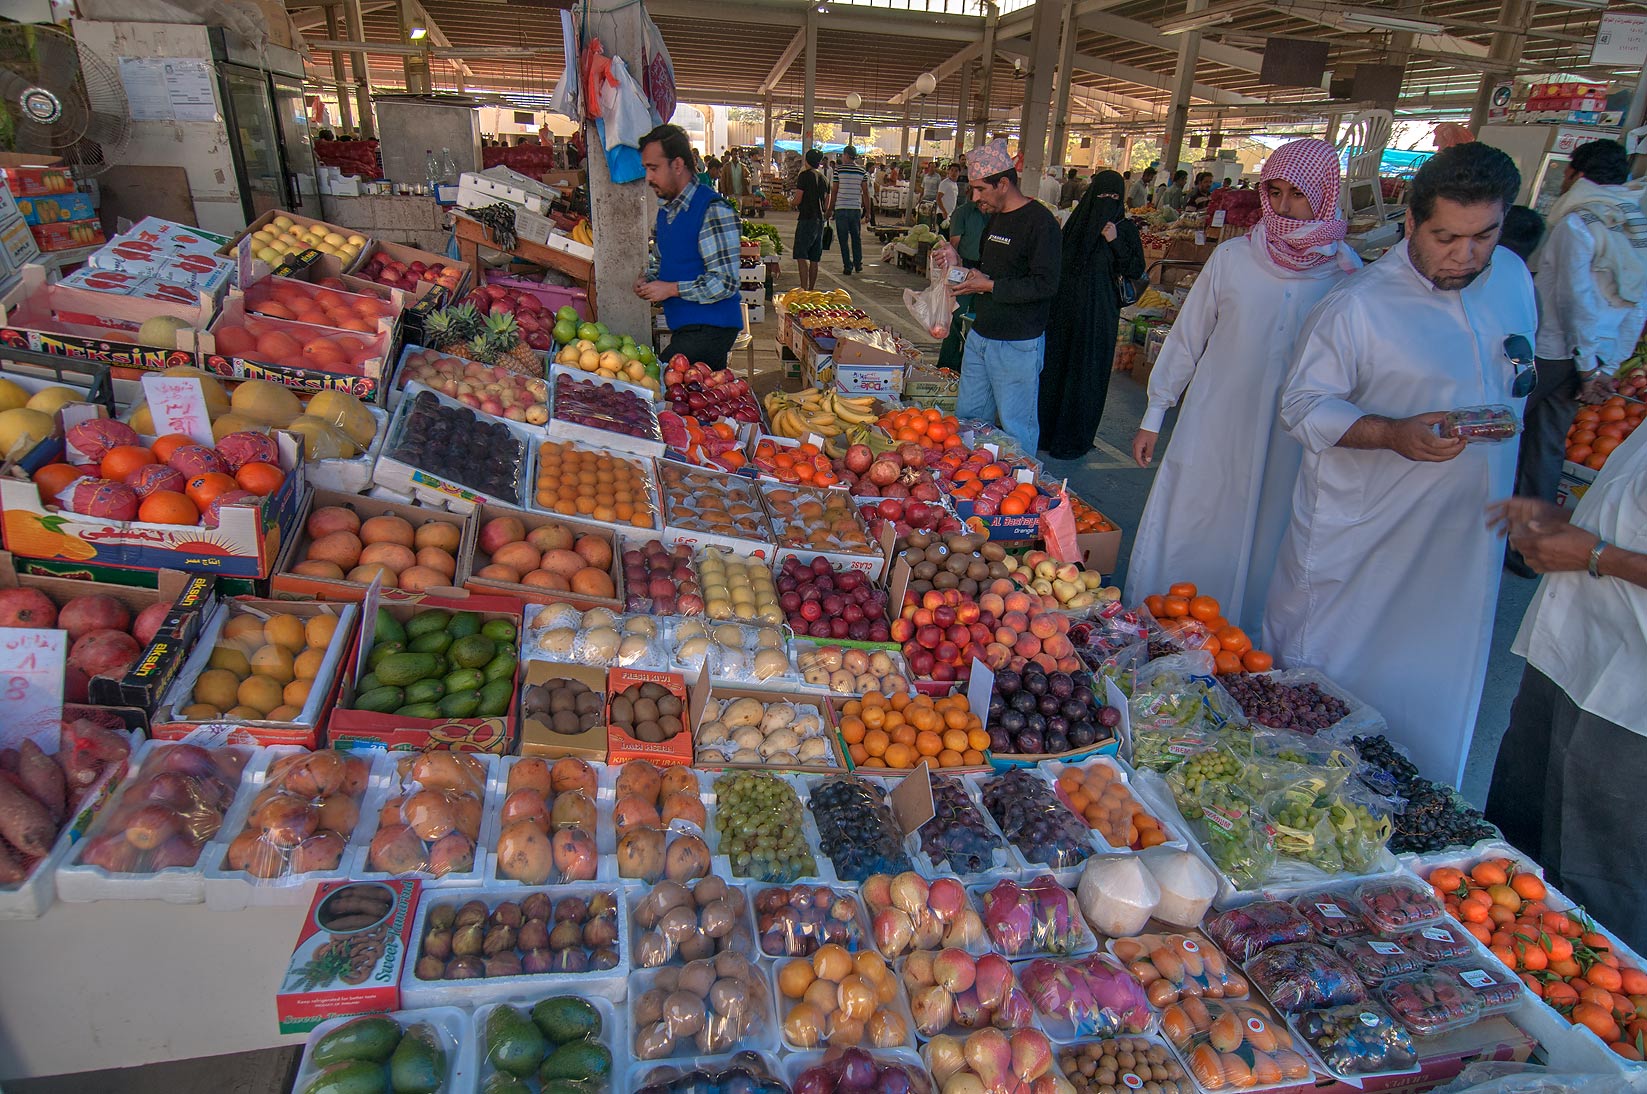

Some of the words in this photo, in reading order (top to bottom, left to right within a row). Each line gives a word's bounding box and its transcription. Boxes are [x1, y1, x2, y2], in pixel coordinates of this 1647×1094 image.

[861, 382, 881, 391] Dole
[622, 672, 650, 681] FRESH
[651, 674, 671, 682] KIWI
[375, 942, 400, 983] Sweet
[388, 880, 415, 937] Tamarind
[285, 1014, 323, 1025] Sweet
